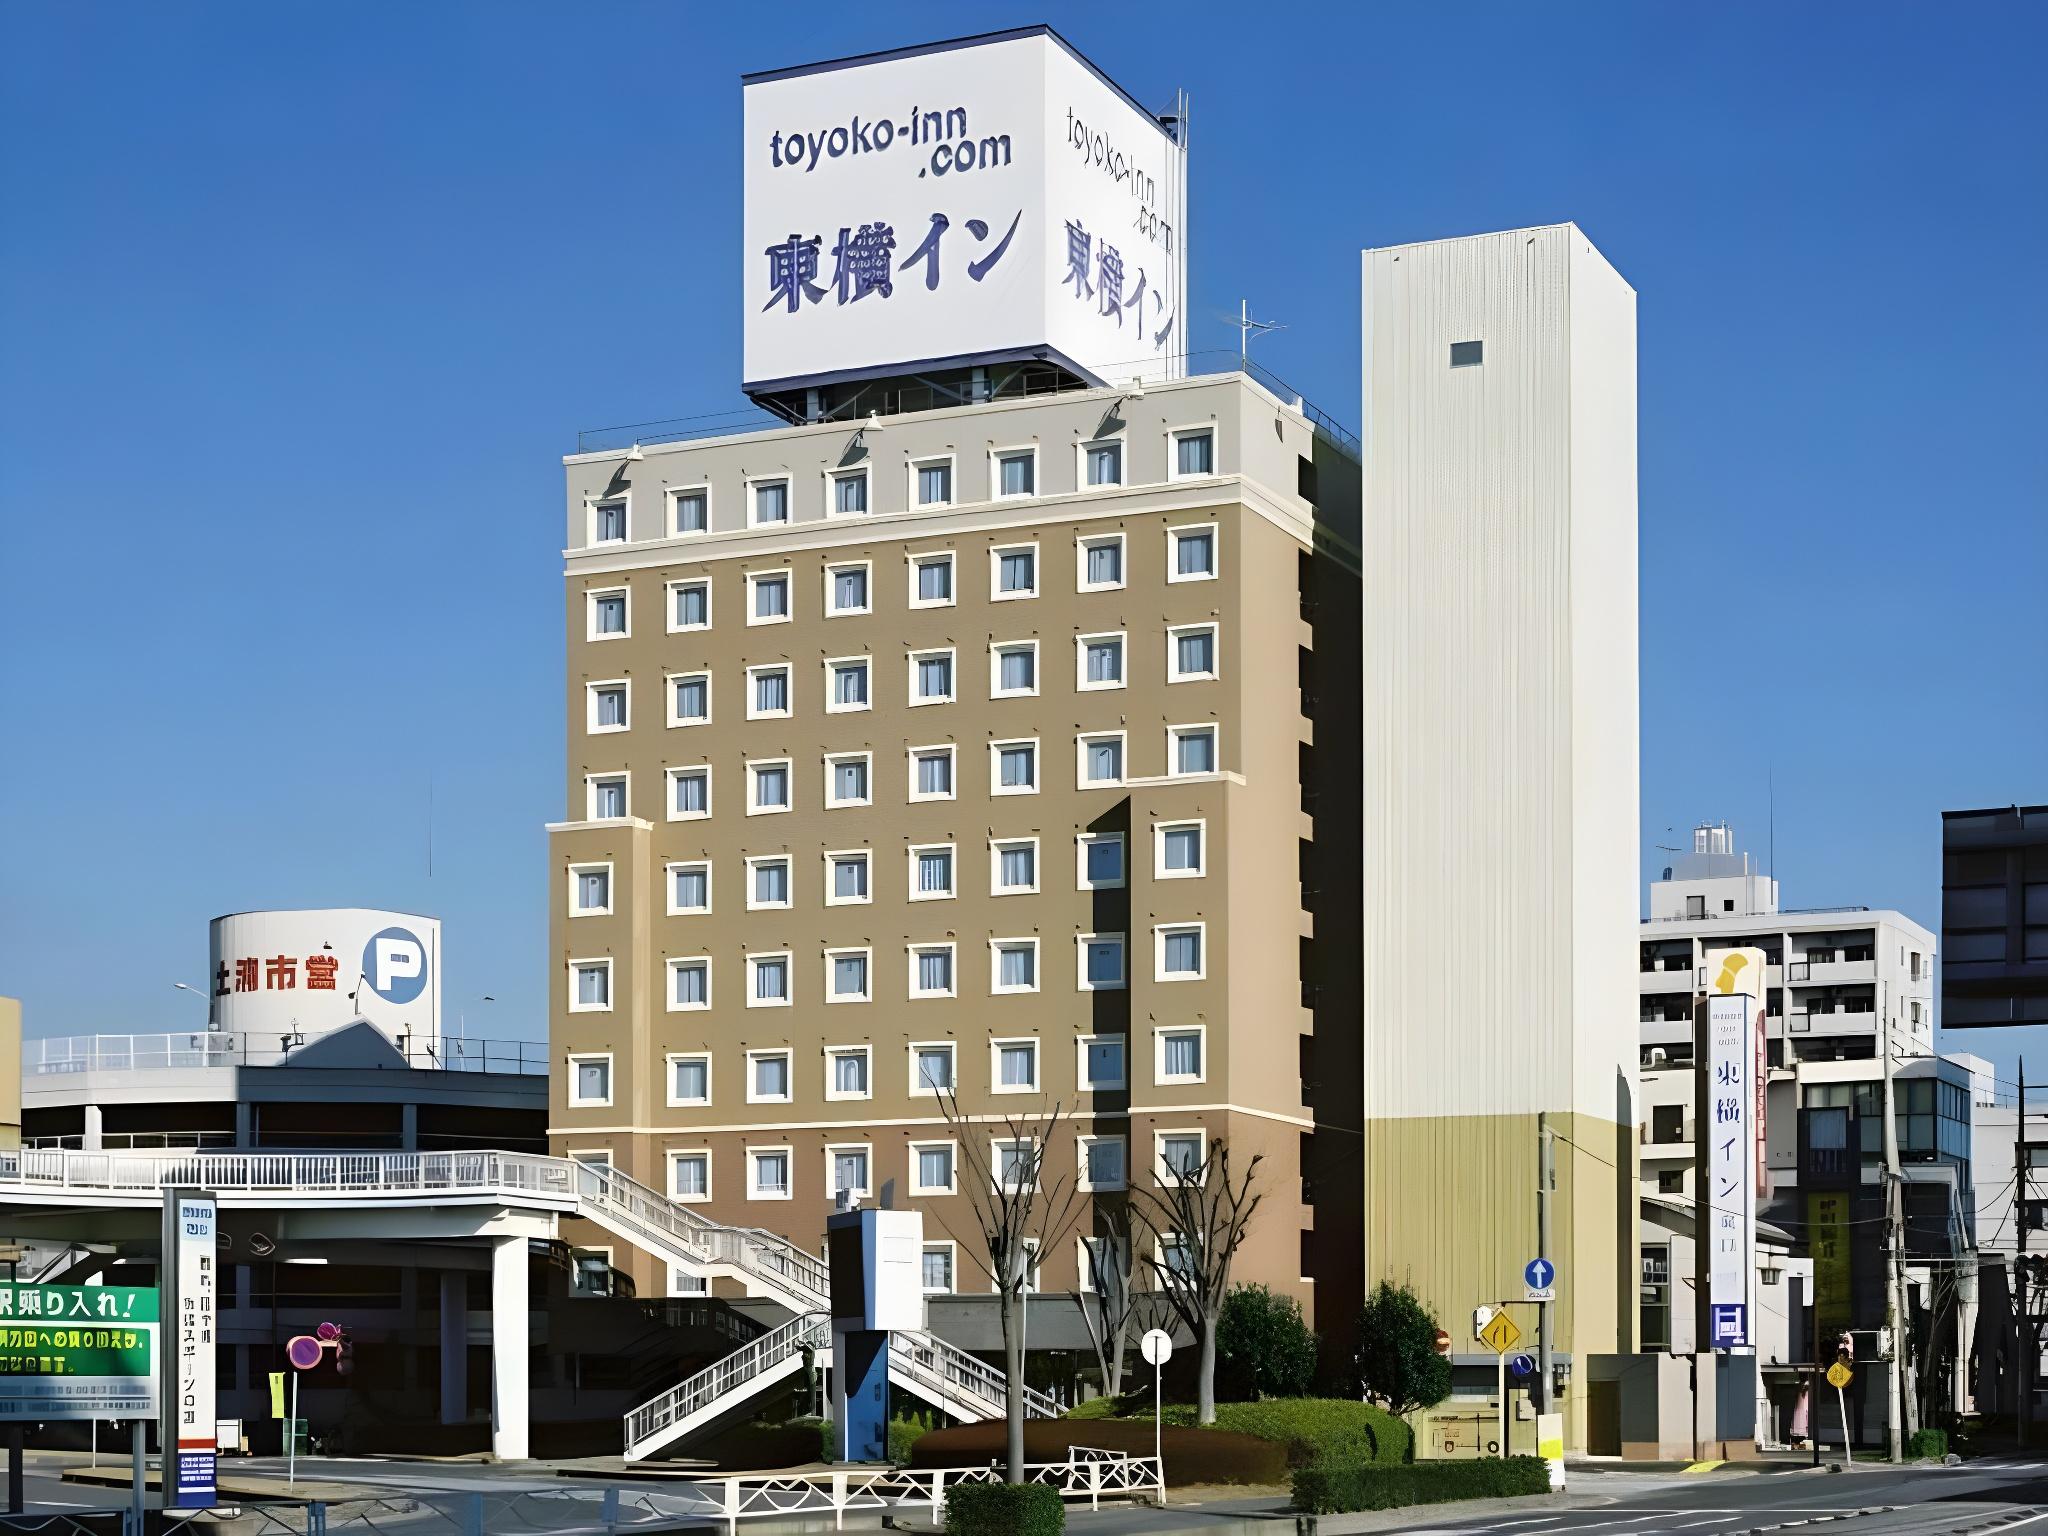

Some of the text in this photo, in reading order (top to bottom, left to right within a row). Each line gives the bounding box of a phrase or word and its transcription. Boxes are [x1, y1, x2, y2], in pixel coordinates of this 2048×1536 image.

[769, 106, 967, 172] toyoko-inn
[918, 132, 1012, 179] .com
[1067, 106, 1154, 208] toyoko-inn
[376, 937, 422, 991] P
